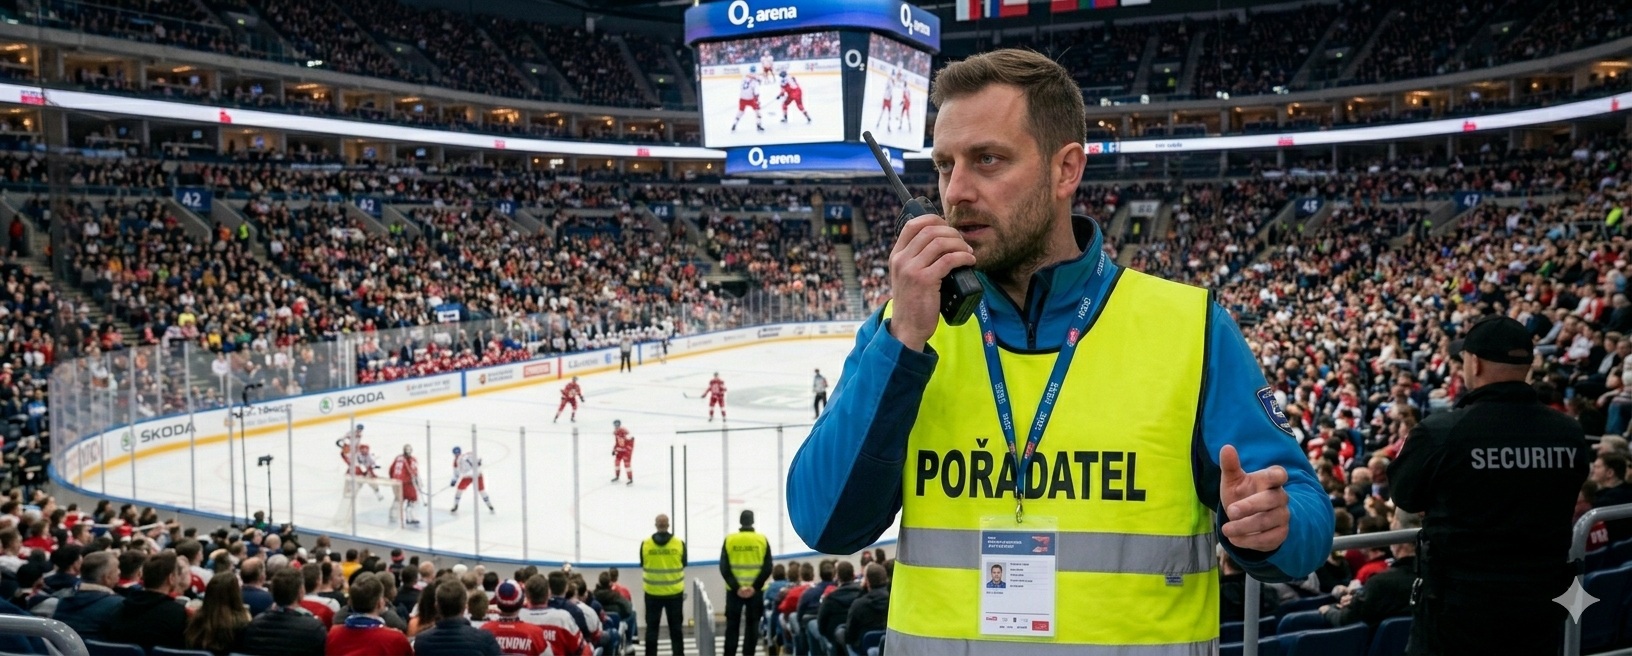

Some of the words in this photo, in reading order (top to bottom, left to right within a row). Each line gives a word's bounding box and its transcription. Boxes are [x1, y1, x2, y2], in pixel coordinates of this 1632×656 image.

[756, 6, 797, 22] arena
[769, 153, 801, 165] arena
[182, 192, 202, 207] A2
[1470, 446, 1577, 470] SECURITY
[916, 438, 1147, 502] POŘADATEL
